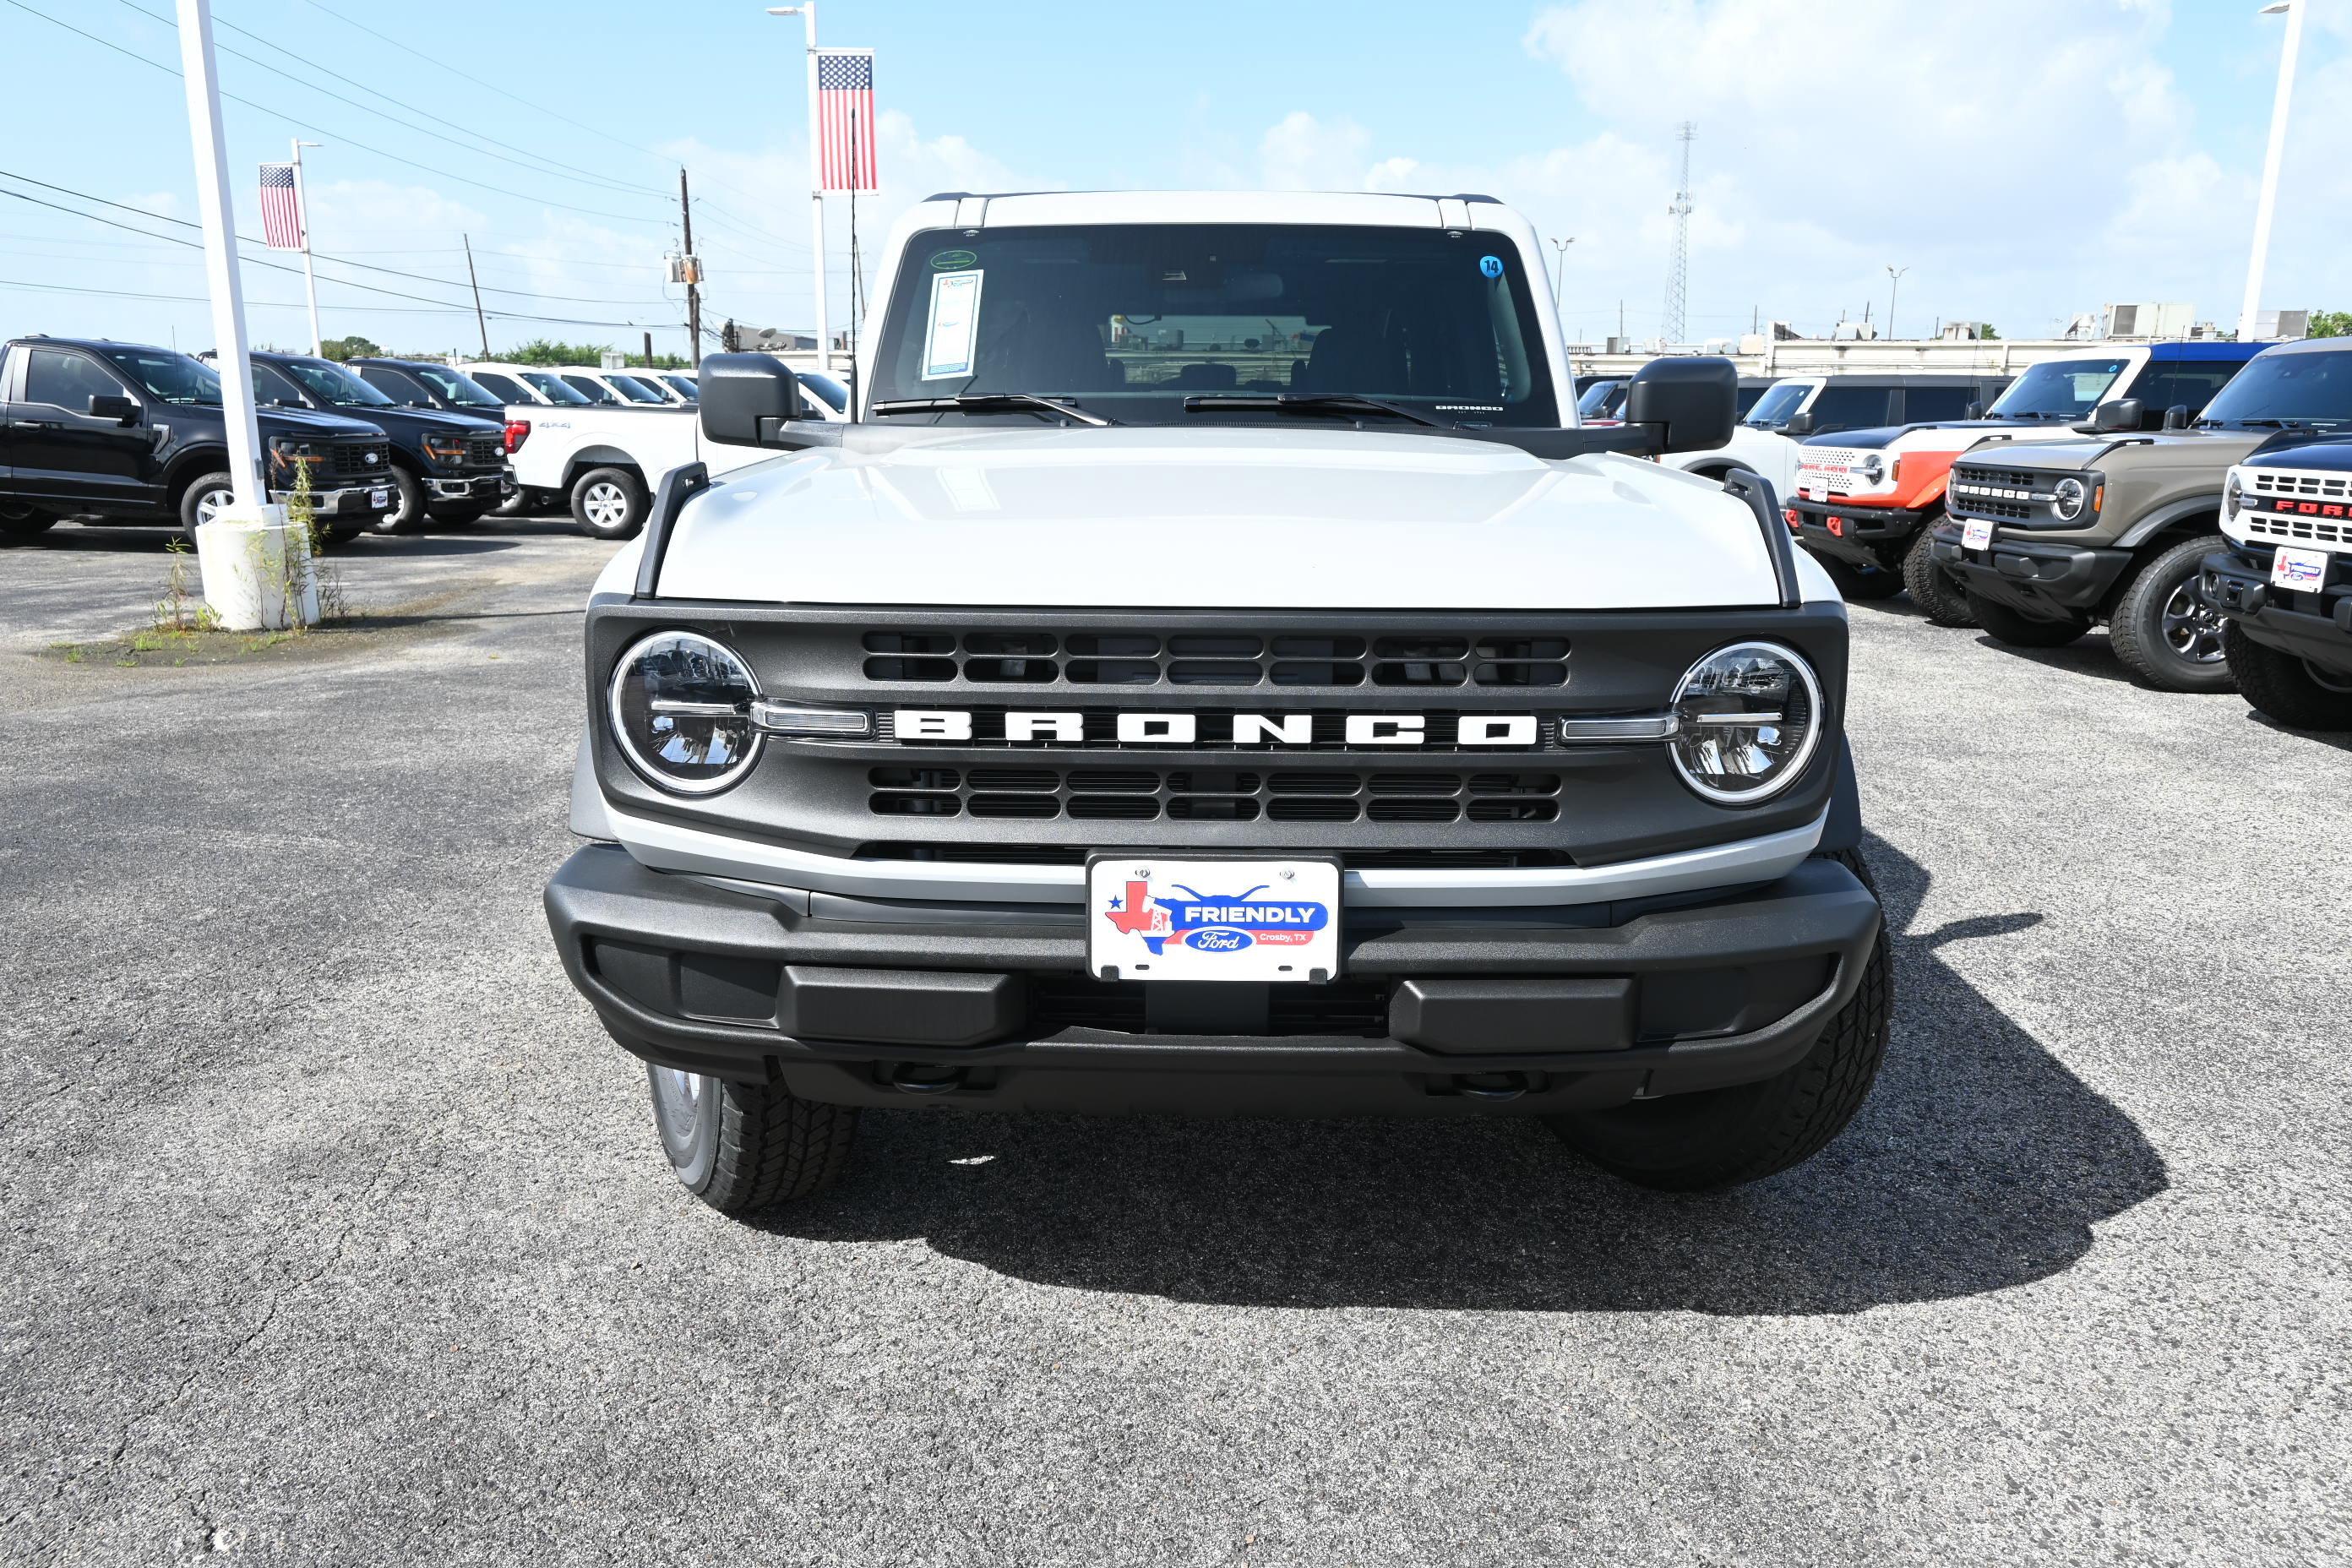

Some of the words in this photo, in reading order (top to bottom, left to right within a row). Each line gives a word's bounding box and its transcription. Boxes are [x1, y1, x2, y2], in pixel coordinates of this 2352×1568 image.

[1484, 259, 1499, 273] 14
[1958, 484, 2029, 500] BRONCO
[2276, 499, 2352, 518] FOR
[893, 710, 1538, 745] BRONCO
[1184, 906, 1317, 923] FRIENDLY
[1197, 931, 1240, 950] Ford
[1259, 933, 1293, 943] Crosby,
